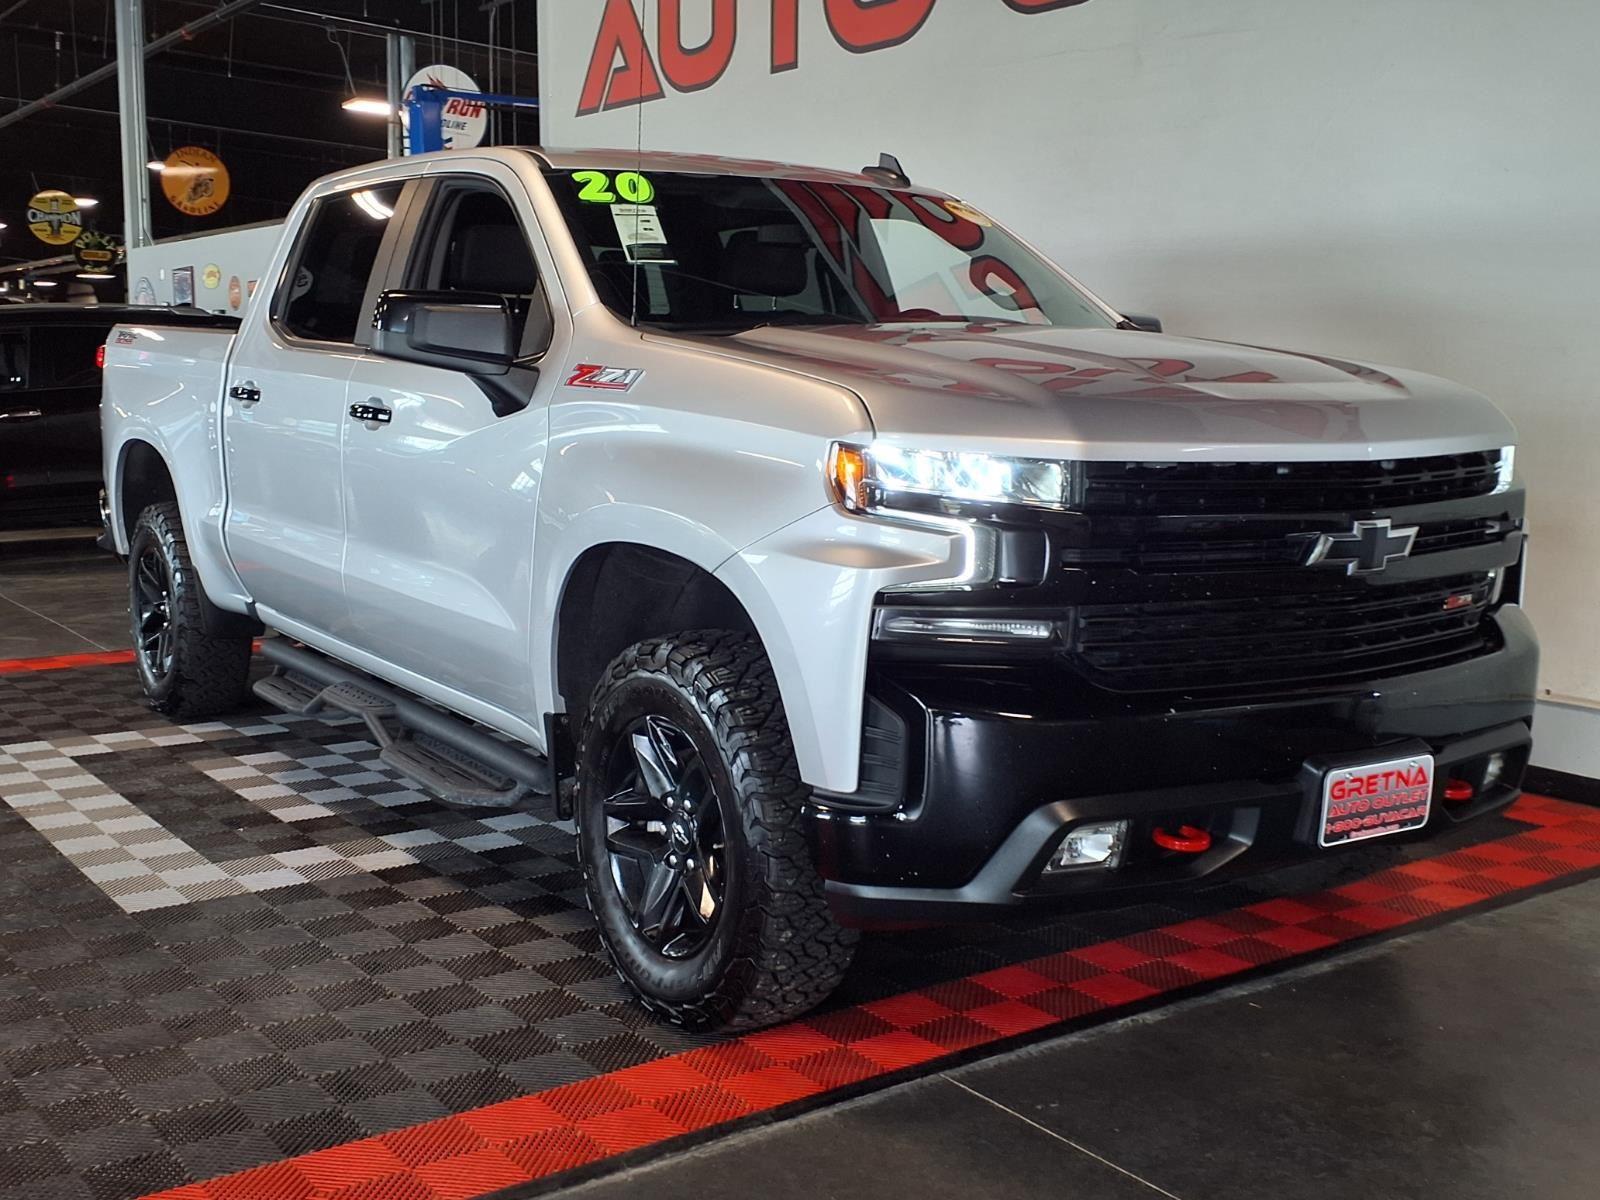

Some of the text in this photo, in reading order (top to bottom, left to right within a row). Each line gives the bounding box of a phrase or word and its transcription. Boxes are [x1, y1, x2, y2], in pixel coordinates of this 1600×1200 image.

[571, 171, 655, 204] 20
[564, 363, 646, 393] Z71
[1331, 767, 1428, 800] GRETNA
[1328, 791, 1427, 818] AUTO OUTLET
